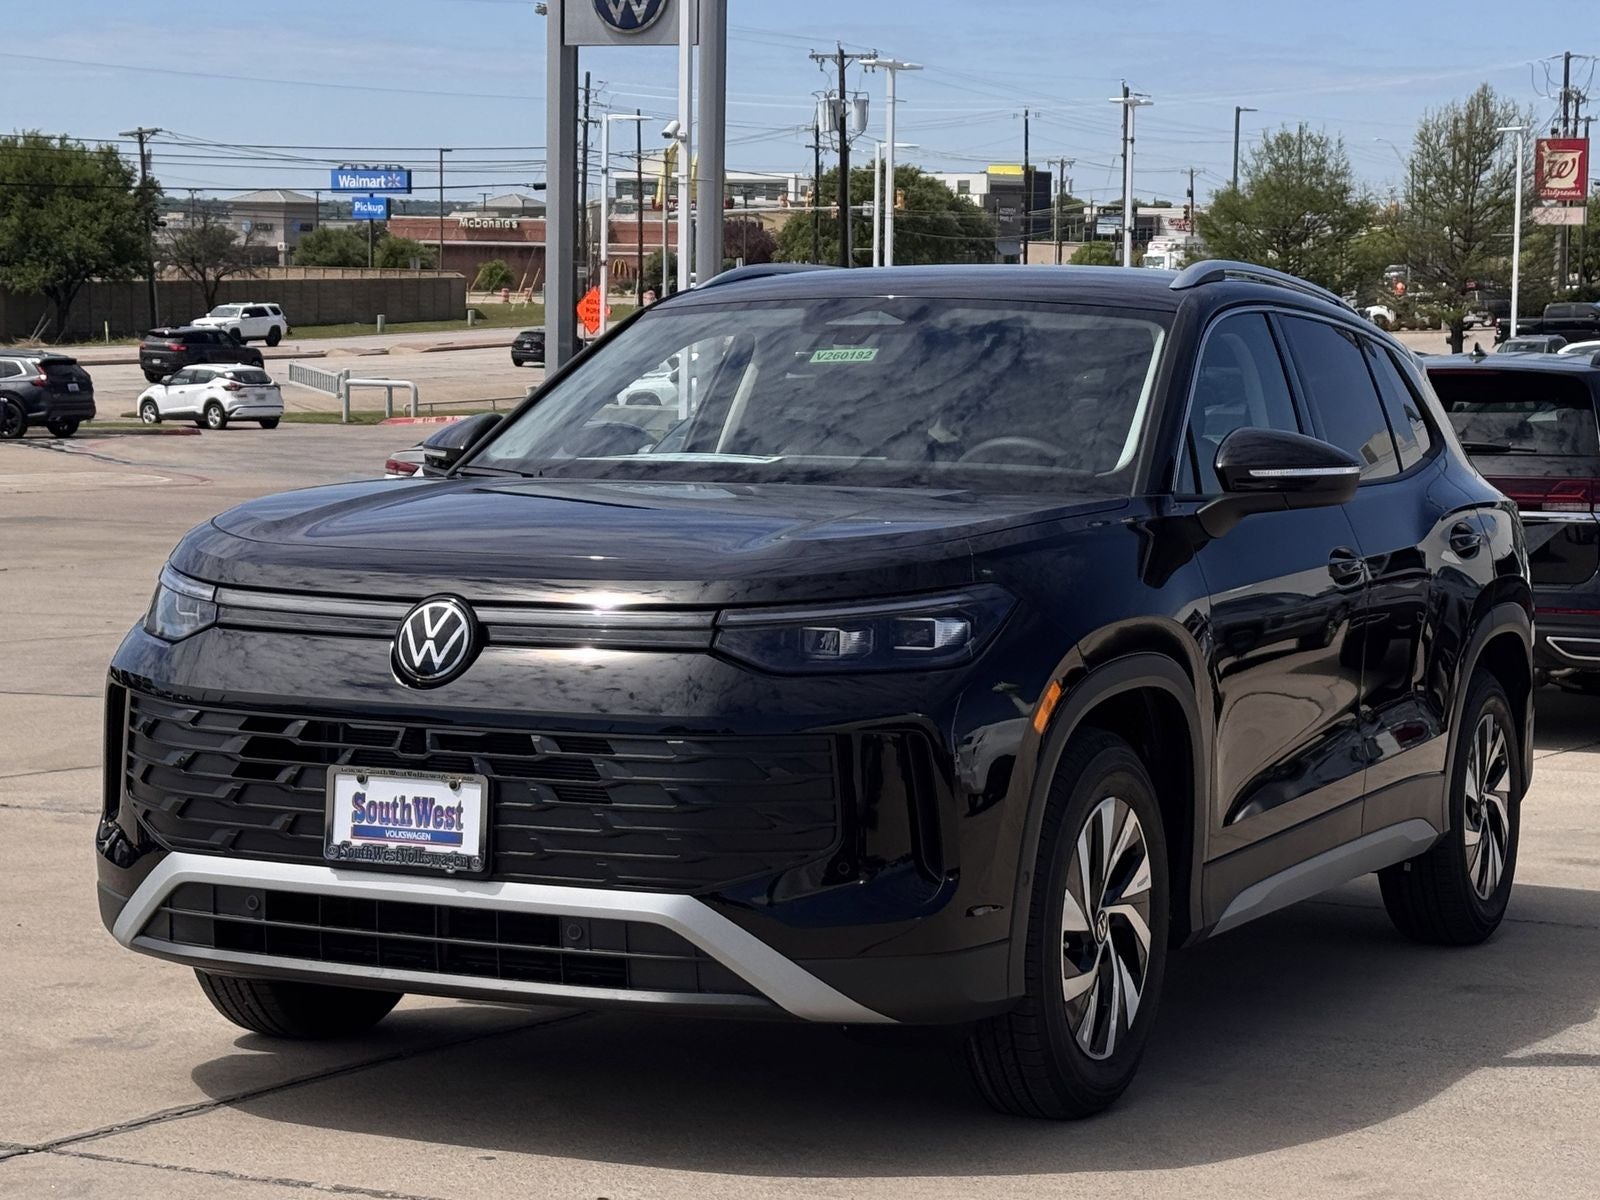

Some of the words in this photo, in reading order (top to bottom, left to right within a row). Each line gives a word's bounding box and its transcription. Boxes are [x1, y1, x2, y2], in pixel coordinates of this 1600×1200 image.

[338, 174, 386, 188] Walmart
[354, 201, 384, 215] Pickup
[459, 217, 518, 229] McDonald's
[352, 791, 464, 831] SouthWest
[385, 830, 431, 841] VOLKSWAGEN
